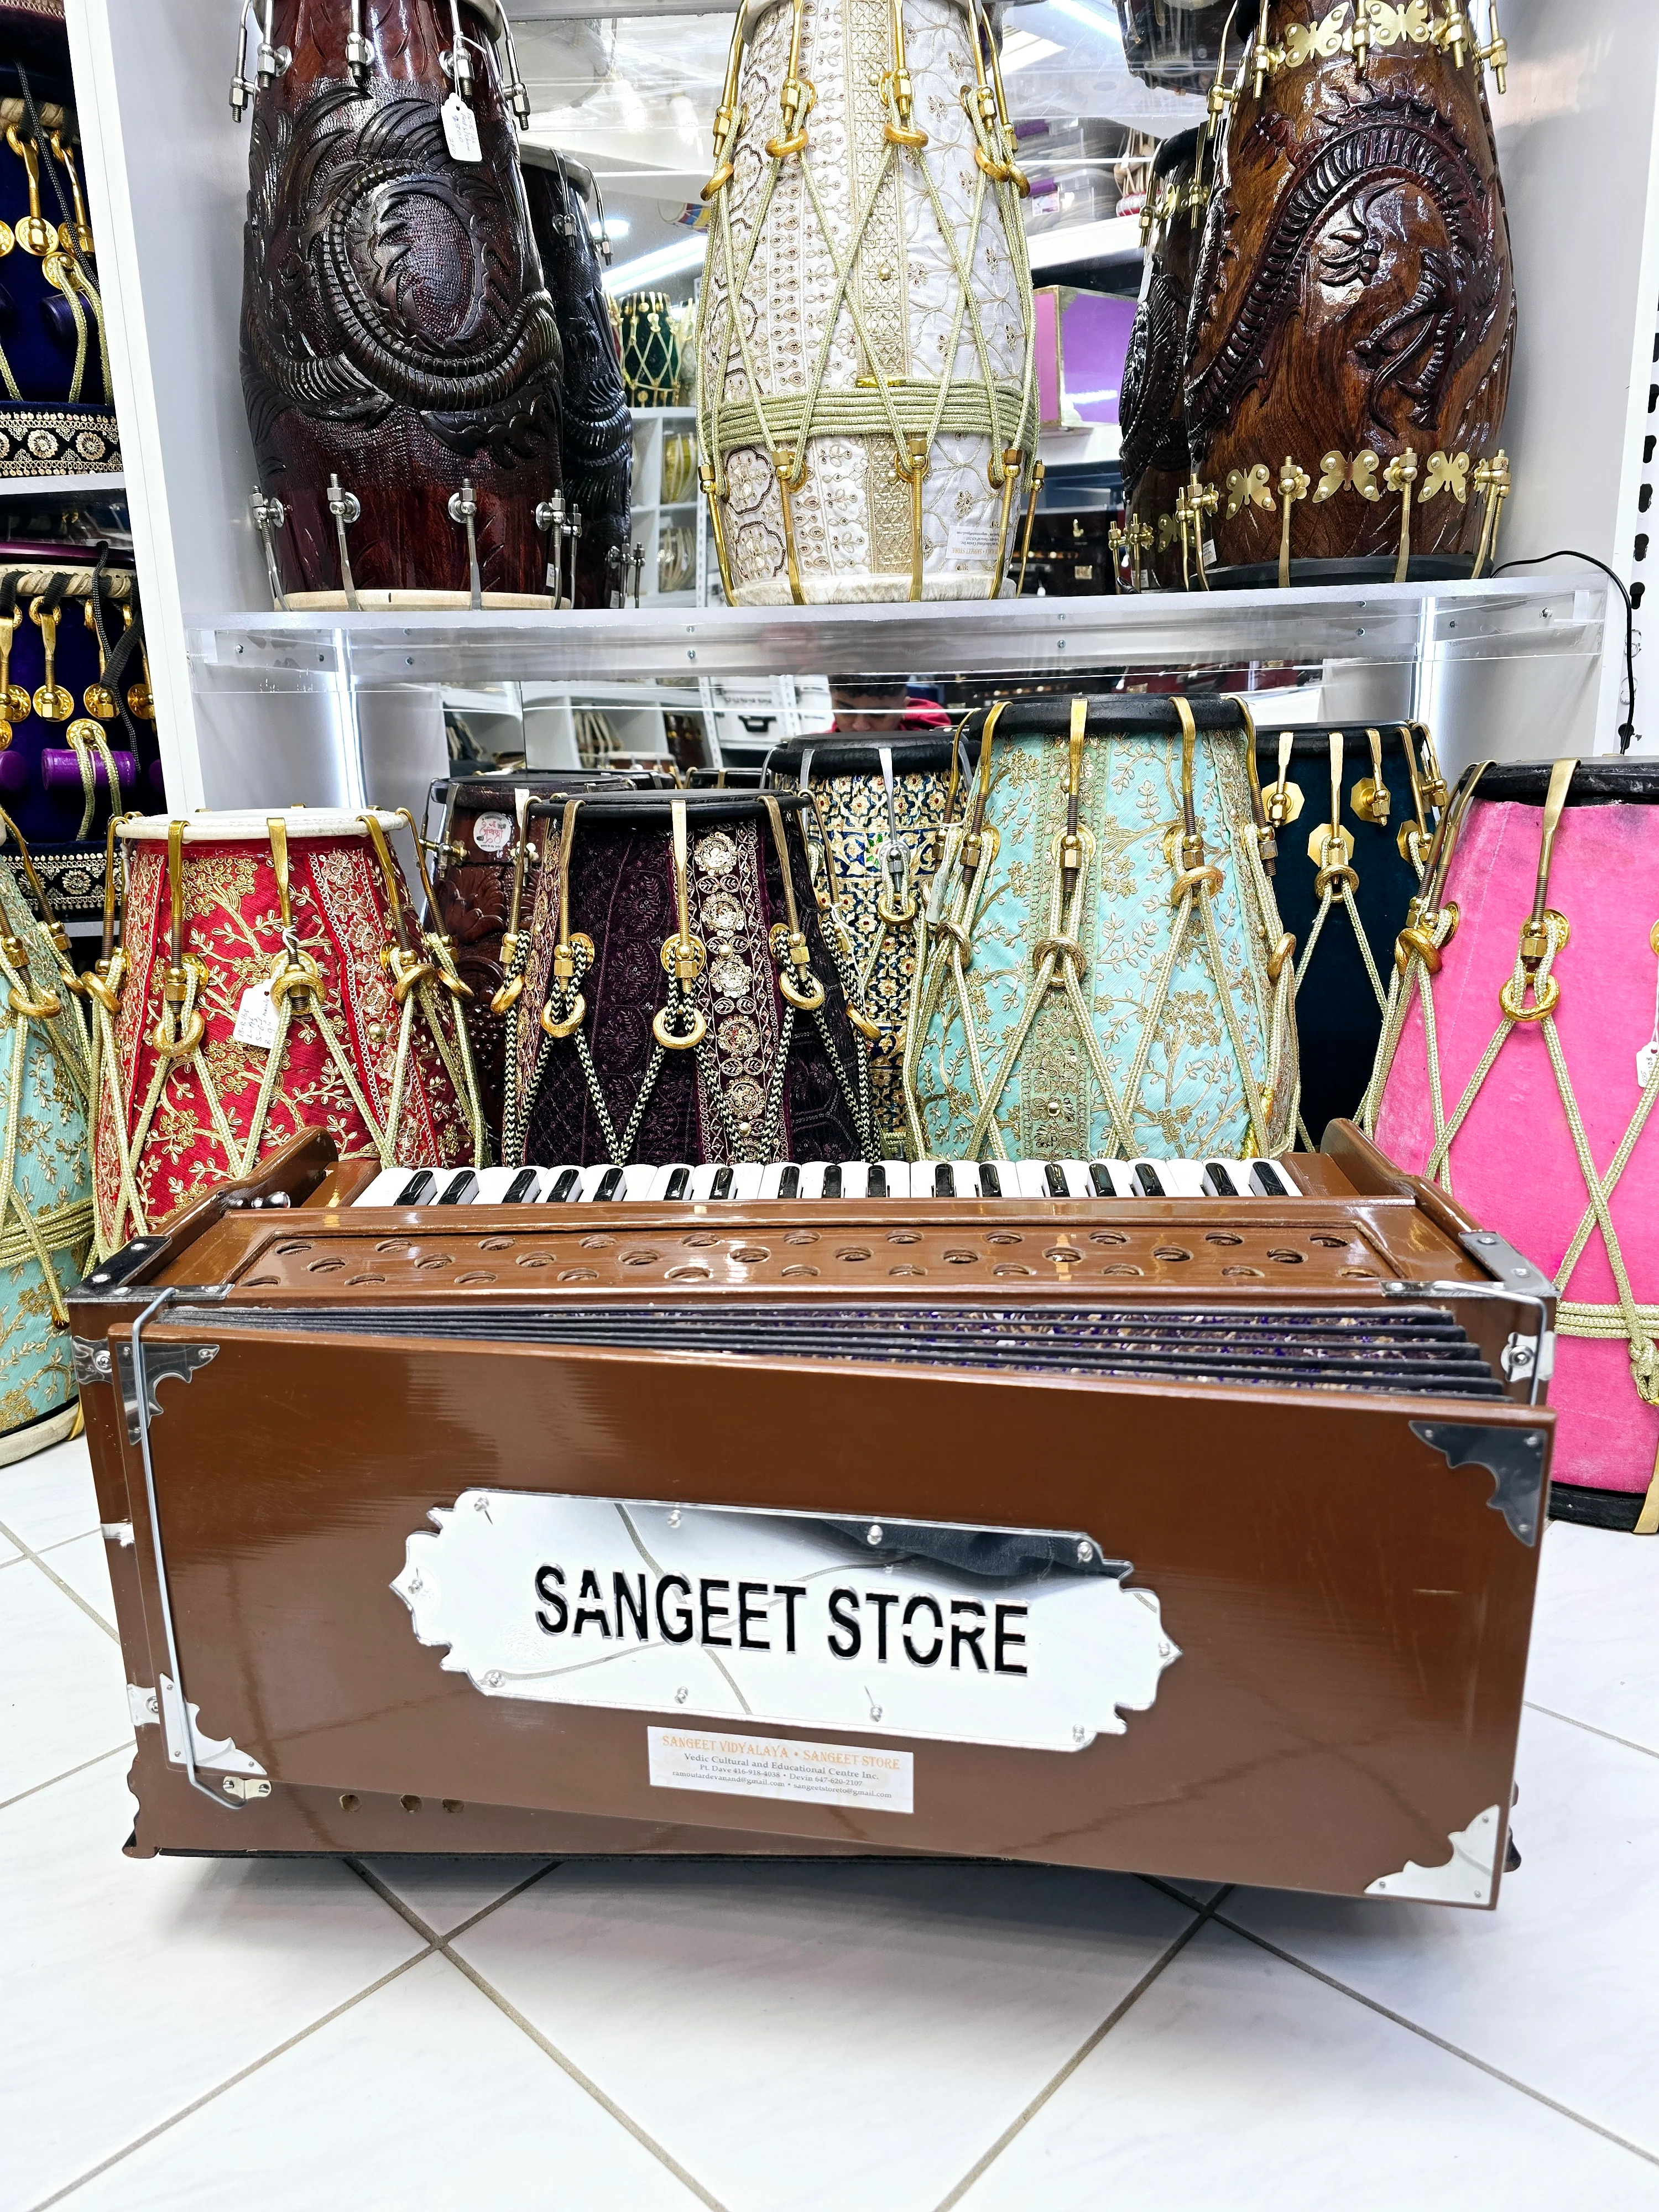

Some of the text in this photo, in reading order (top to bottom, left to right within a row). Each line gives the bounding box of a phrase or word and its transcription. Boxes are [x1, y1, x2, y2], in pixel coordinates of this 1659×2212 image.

[241, 1009, 249, 1020] lbs
[535, 1562, 1030, 1677] SANGEET STORE
[662, 1735, 900, 1770] SANGEET VIDYALAYA SANGEET STORE
[684, 1753, 709, 1762] Vedic
[711, 1756, 749, 1767] Cultural
[771, 1762, 826, 1774] Educational
[828, 1768, 859, 1778] Centre
[862, 1771, 879, 1780] Inc.
[733, 1767, 780, 1778] 416-918-4038
[789, 1773, 813, 1782] Devin
[815, 1776, 863, 1787] 647-620-2107
[672, 1770, 892, 1798] ramoutardevanand@gmail.com sangeetstoreto@gmail.com
